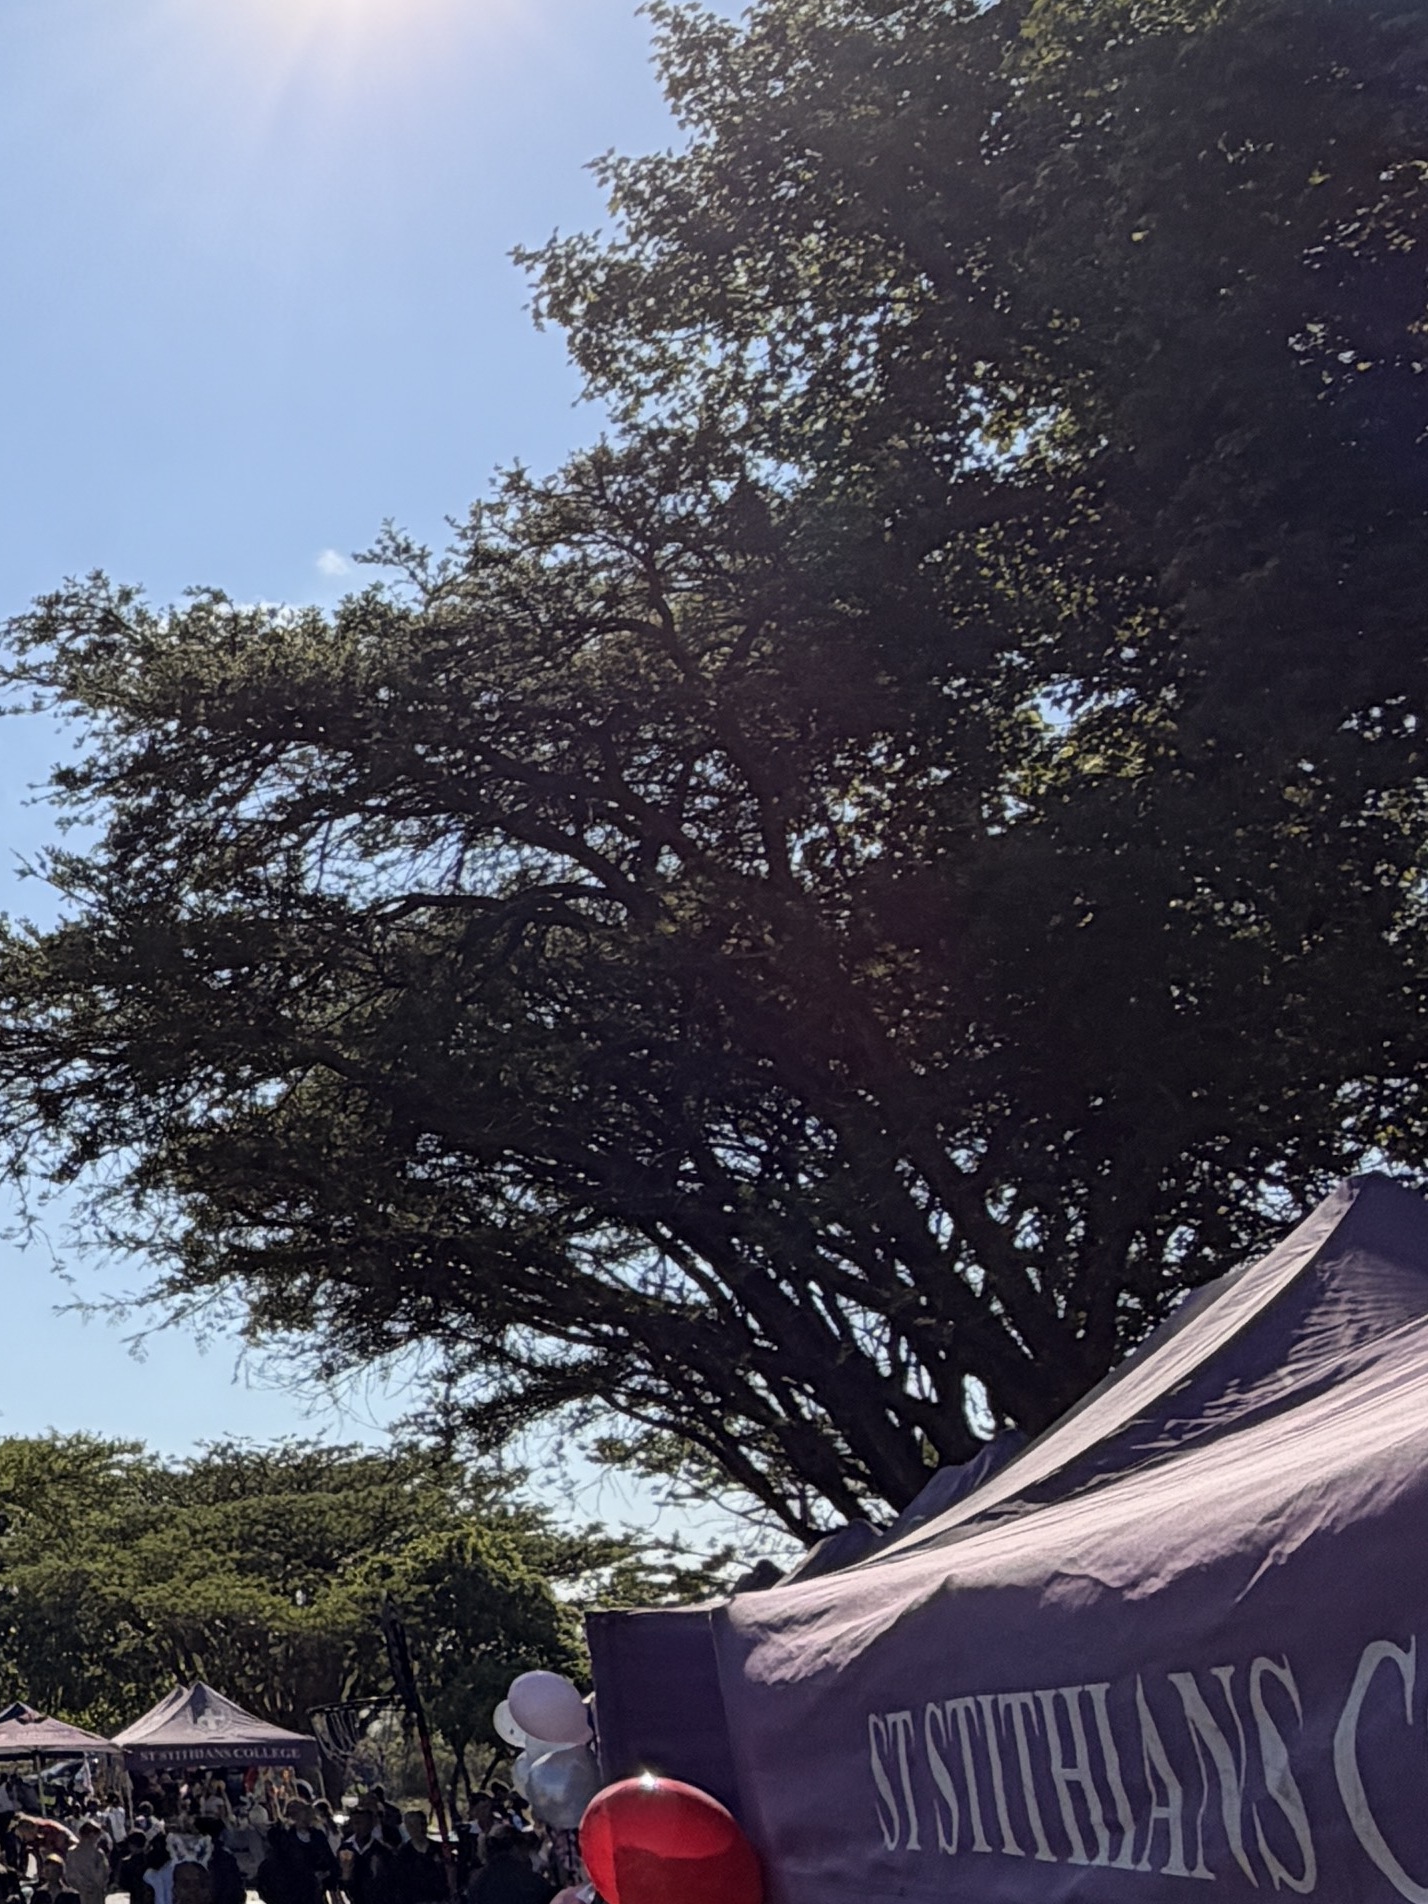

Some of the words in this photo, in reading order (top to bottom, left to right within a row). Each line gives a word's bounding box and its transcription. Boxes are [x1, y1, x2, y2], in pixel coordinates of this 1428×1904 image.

[140, 1751, 156, 1761] ST
[159, 1747, 231, 1761] STITHIANS
[233, 1747, 302, 1759] COLLEGE
[868, 1711, 922, 1853] ST
[925, 1653, 1318, 1895] STITHIANS
